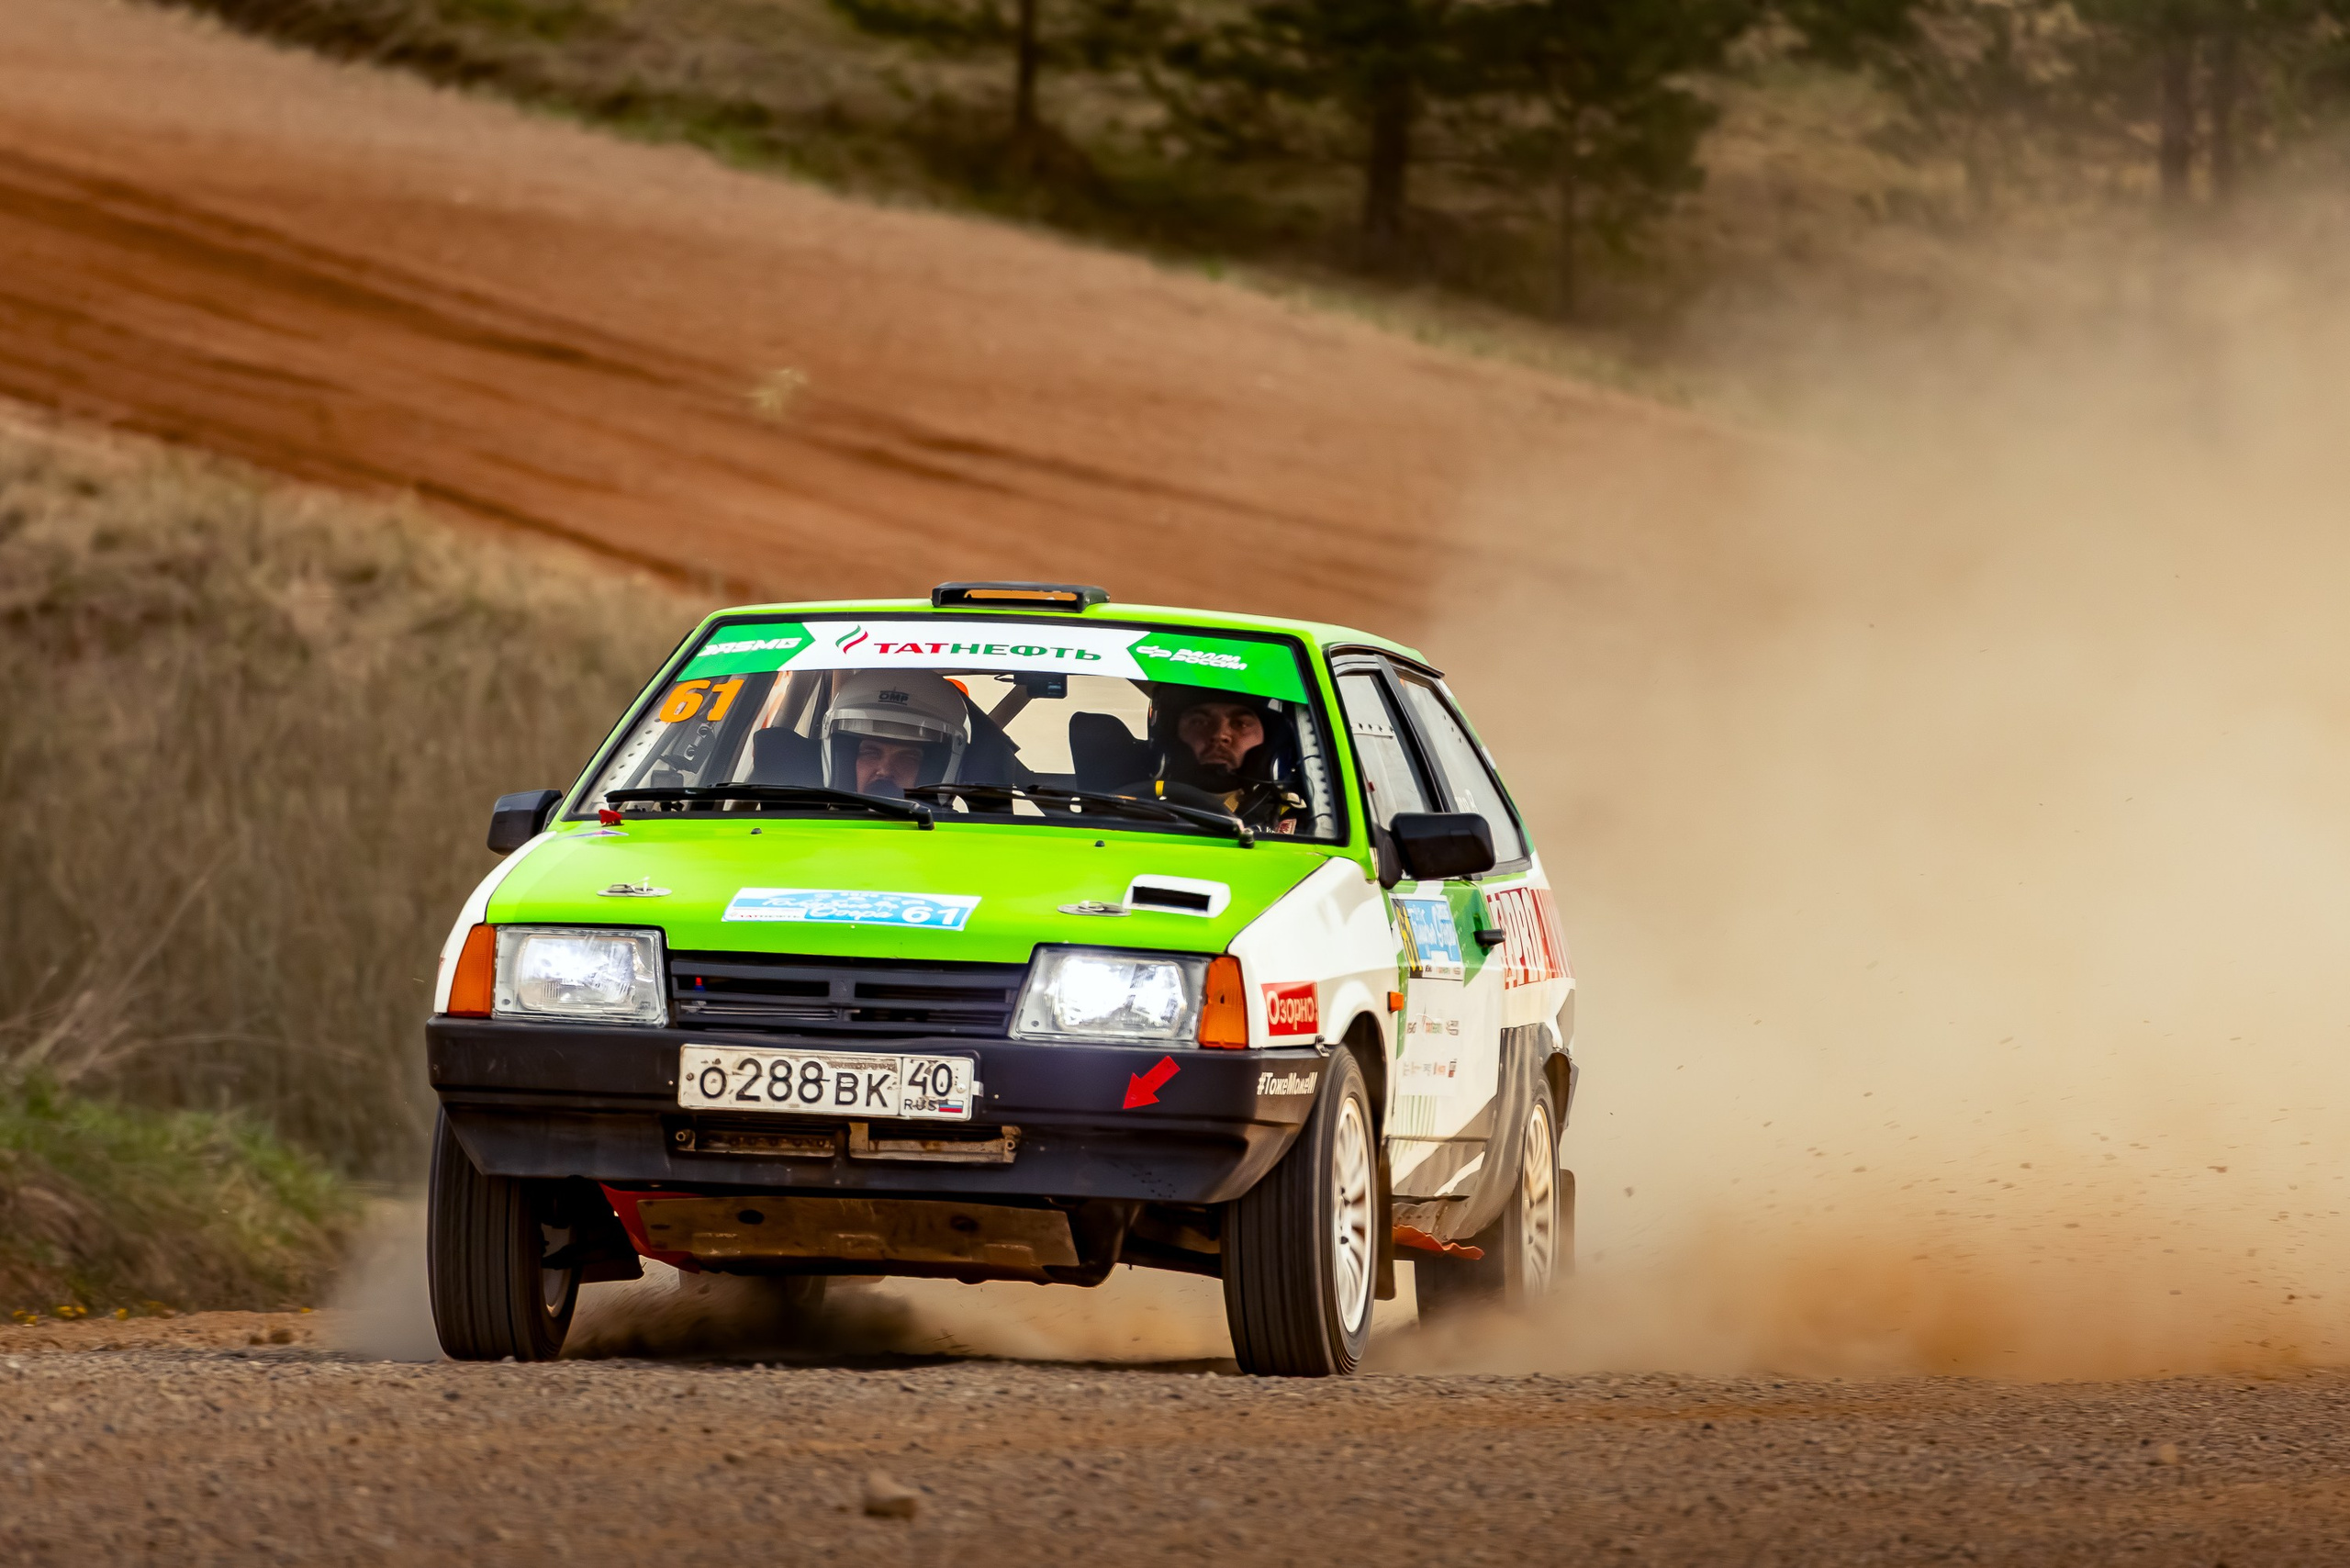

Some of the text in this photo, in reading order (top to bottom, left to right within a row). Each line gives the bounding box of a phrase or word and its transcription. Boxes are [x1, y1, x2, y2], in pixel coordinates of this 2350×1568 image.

[873, 643, 1102, 661] ТАТНЕФТЬ
[659, 678, 744, 722] 61
[901, 906, 962, 926] 61
[908, 1061, 953, 1098] 40
[903, 1098, 938, 1112] RUS
